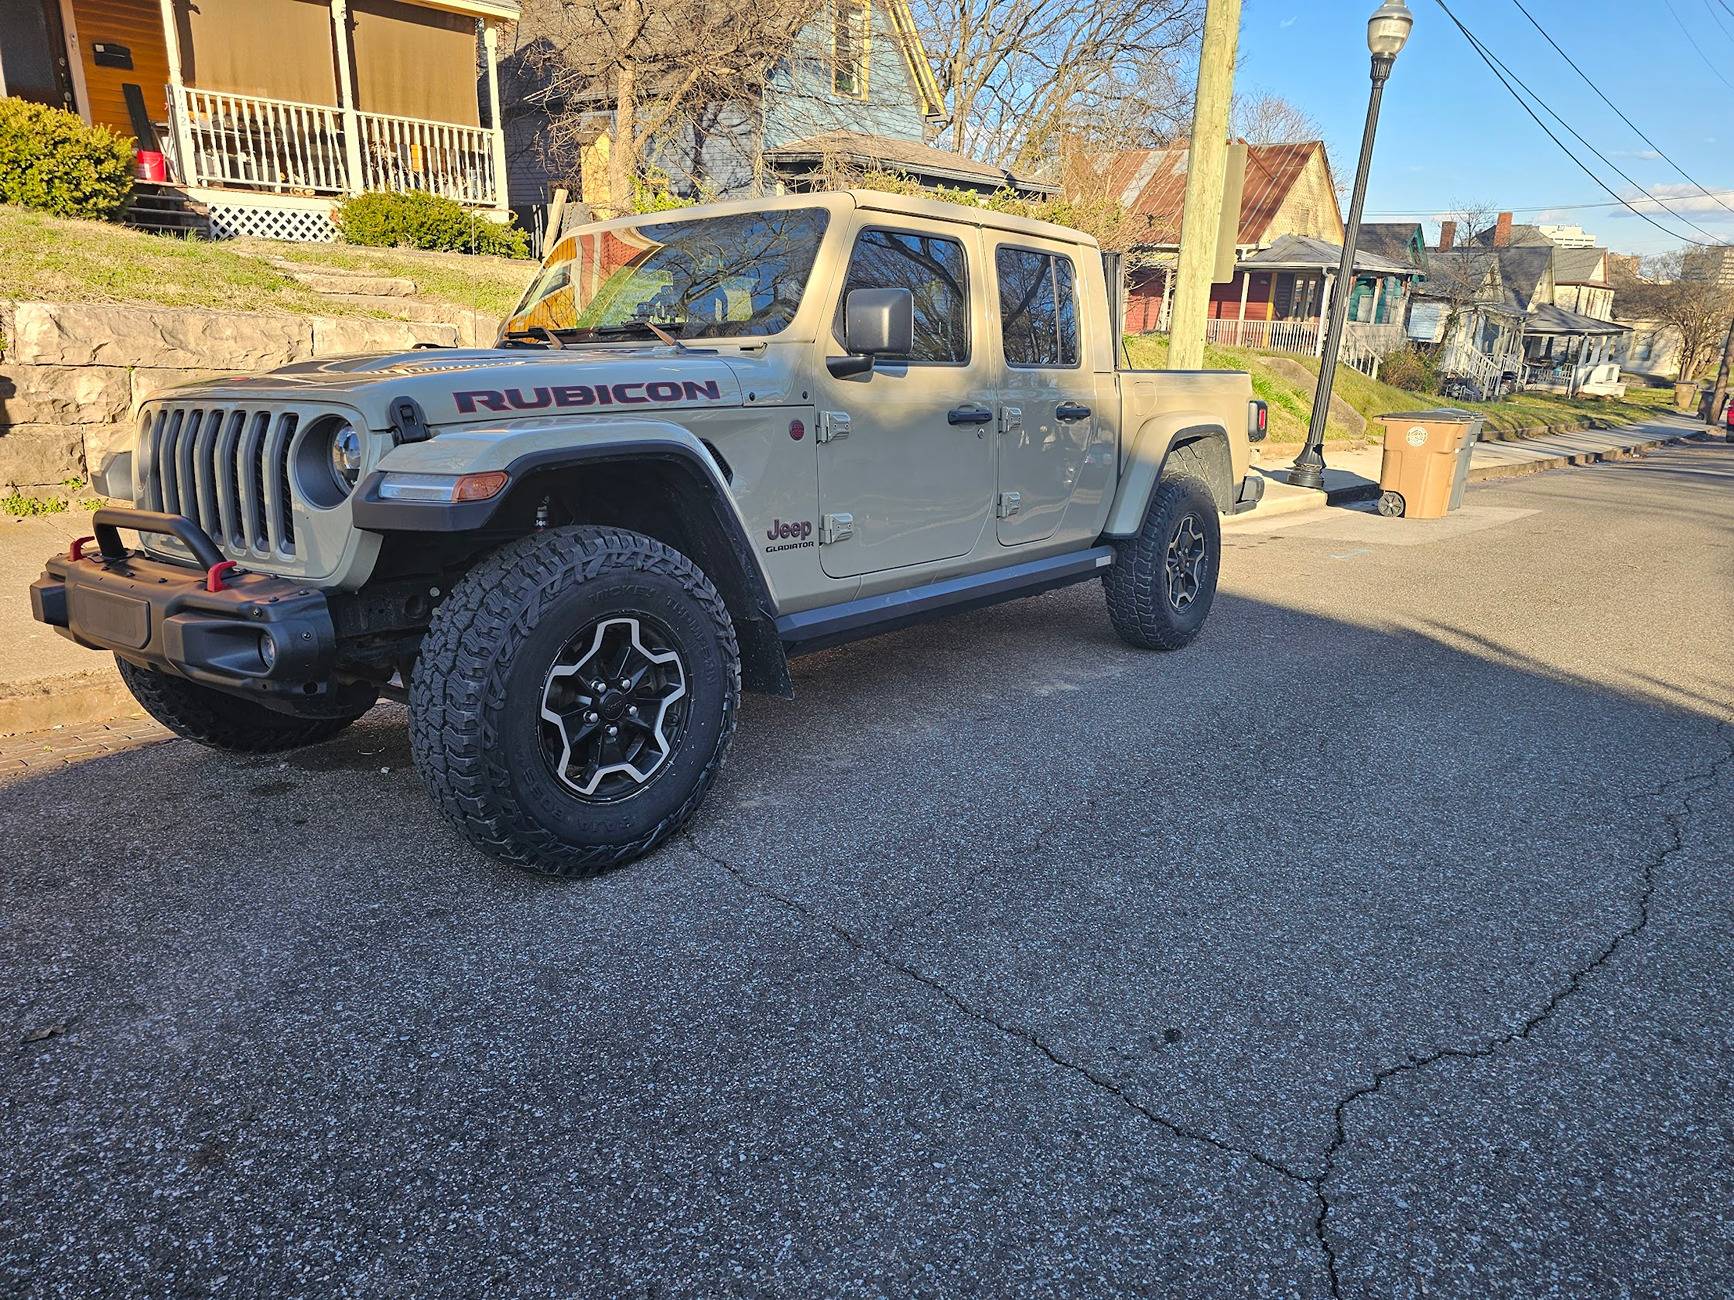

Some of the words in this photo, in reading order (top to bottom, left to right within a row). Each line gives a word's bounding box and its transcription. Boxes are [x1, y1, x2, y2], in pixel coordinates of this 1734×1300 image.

[452, 380, 720, 414] RUBICON
[767, 519, 812, 540] Jeep
[765, 541, 814, 553] GLADIATOR
